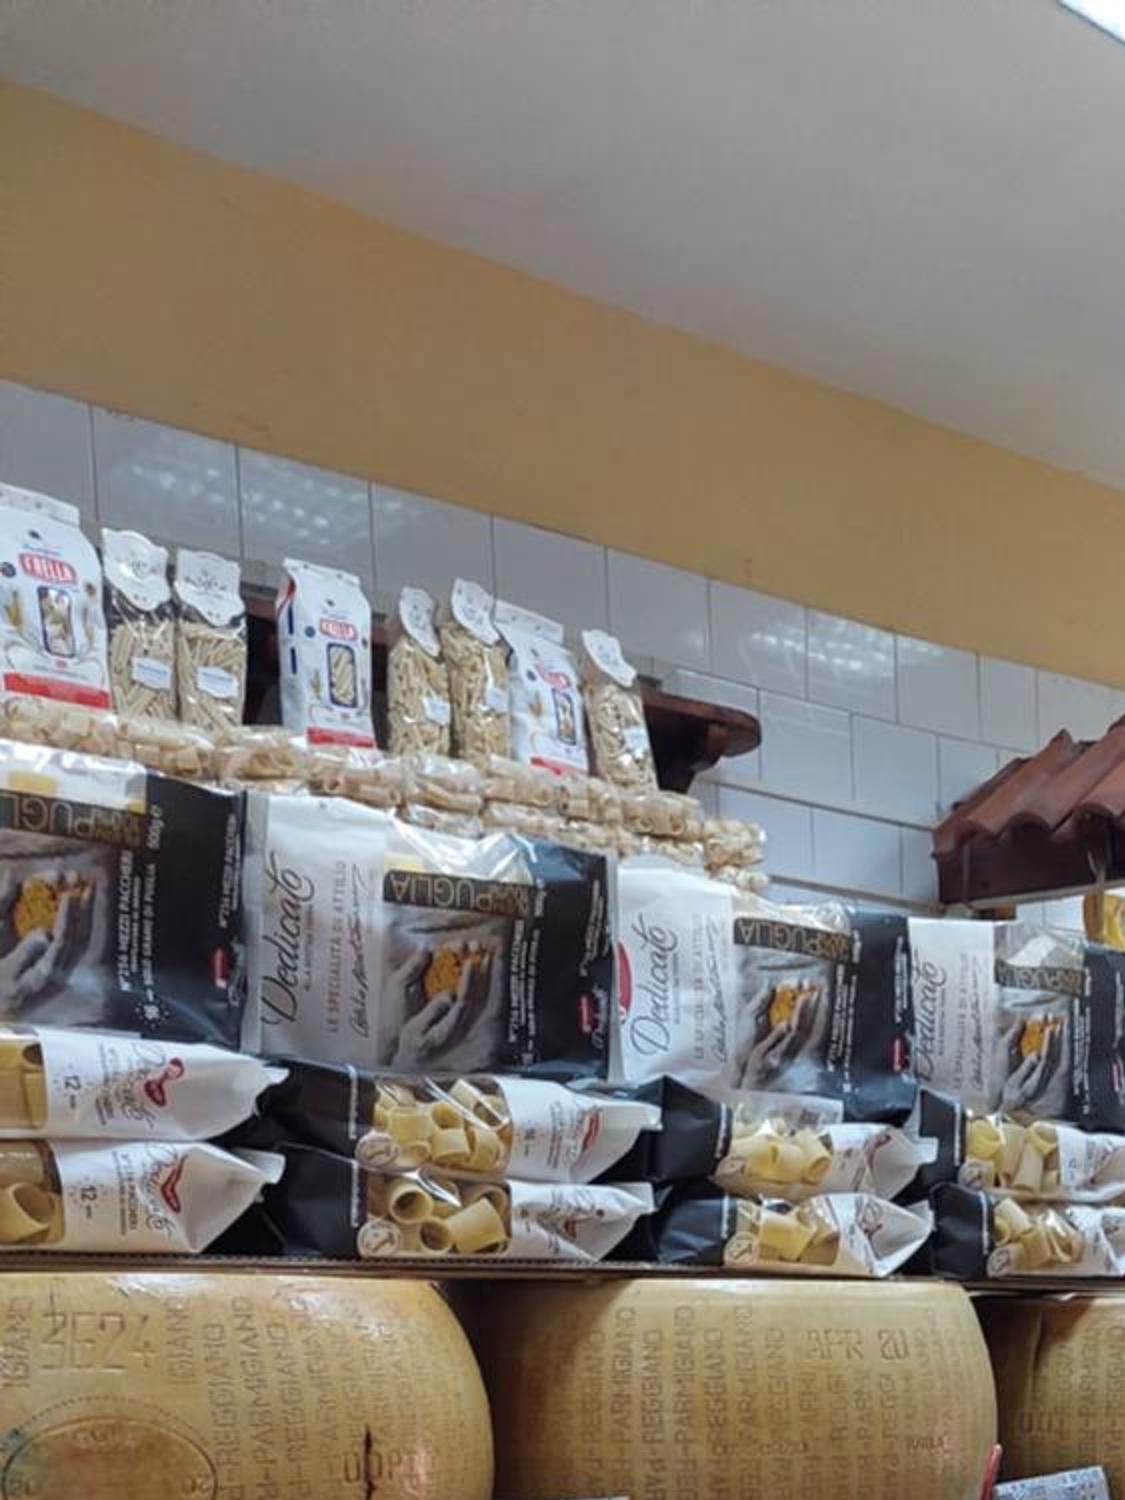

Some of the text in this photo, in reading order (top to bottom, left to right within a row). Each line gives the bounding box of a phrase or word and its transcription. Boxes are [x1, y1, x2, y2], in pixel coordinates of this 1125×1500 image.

[262, 853, 314, 1025] Dedicato
[630, 912, 678, 1056] Dedicato
[611, 1307, 636, 1443] PARMIGIANO
[642, 1329, 666, 1444] REGGIANO
[674, 1306, 697, 1443] PARMIGIANO
